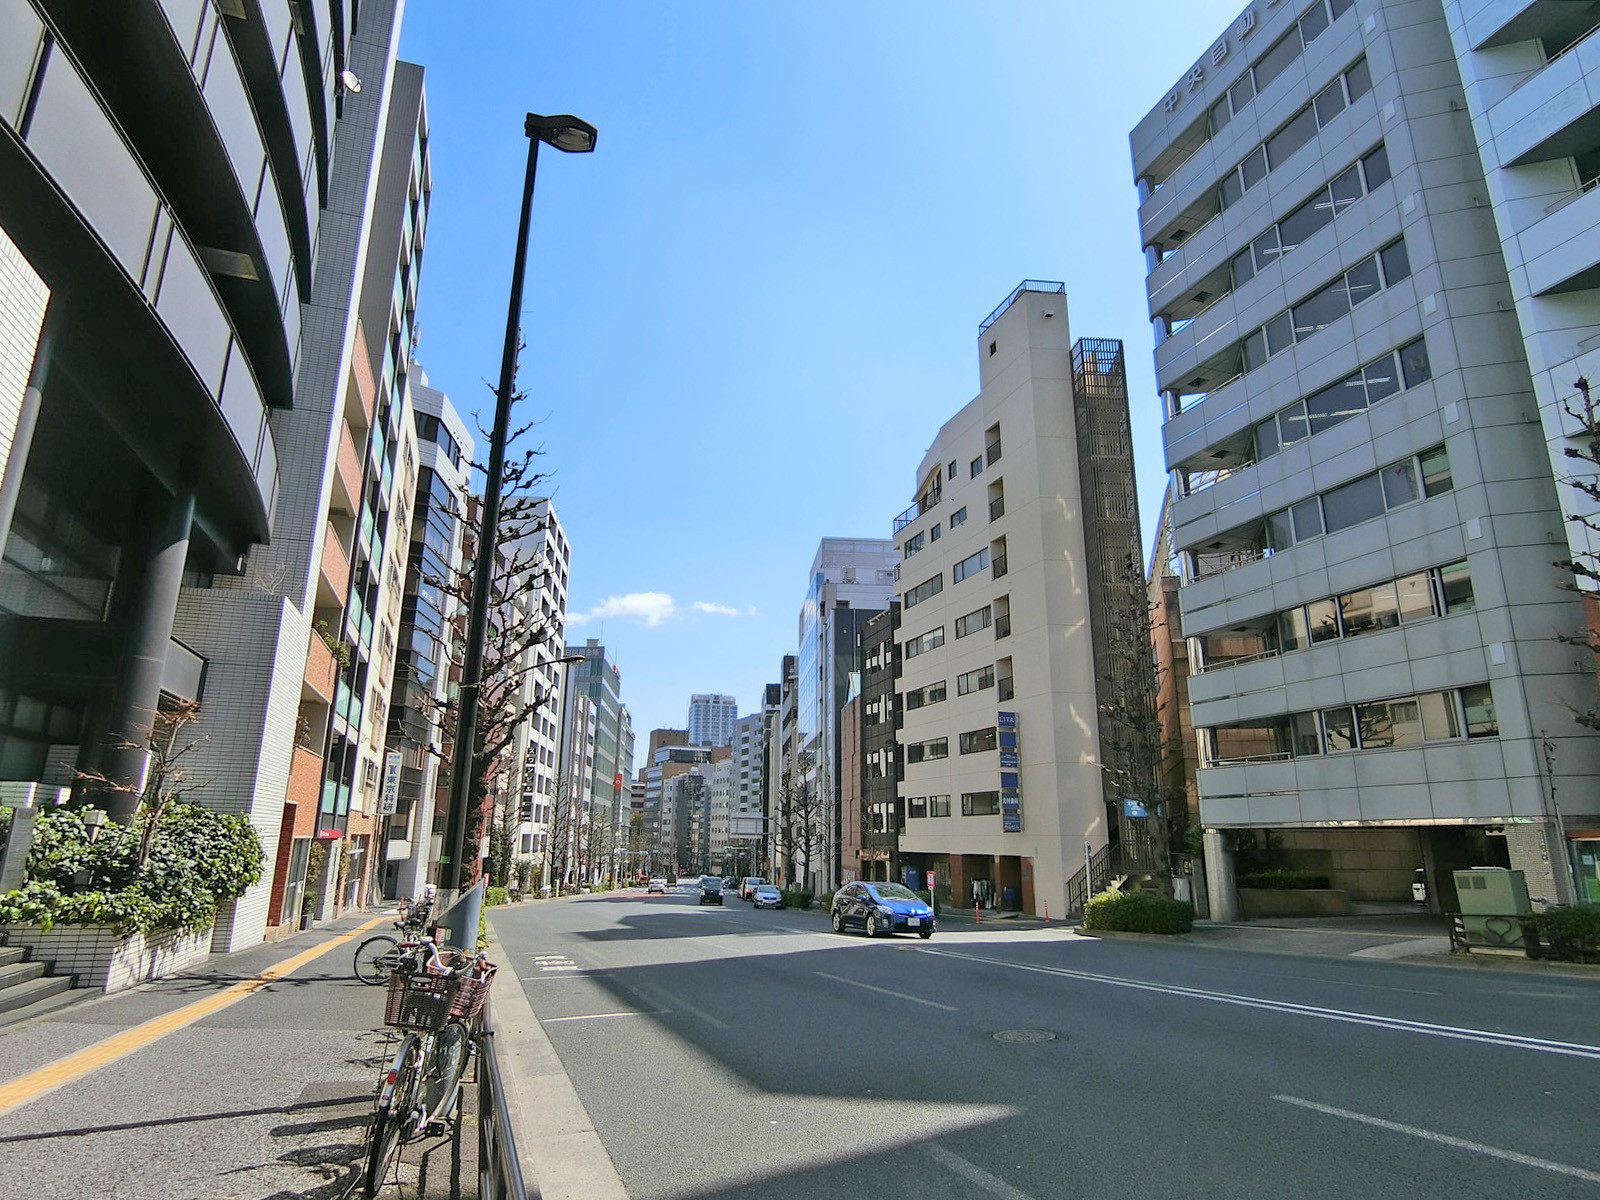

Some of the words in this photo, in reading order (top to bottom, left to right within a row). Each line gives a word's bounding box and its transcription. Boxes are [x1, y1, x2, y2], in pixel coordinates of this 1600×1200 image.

[1164, 0, 1278, 112] 中央自動
[383, 776, 396, 811] 東京科研
